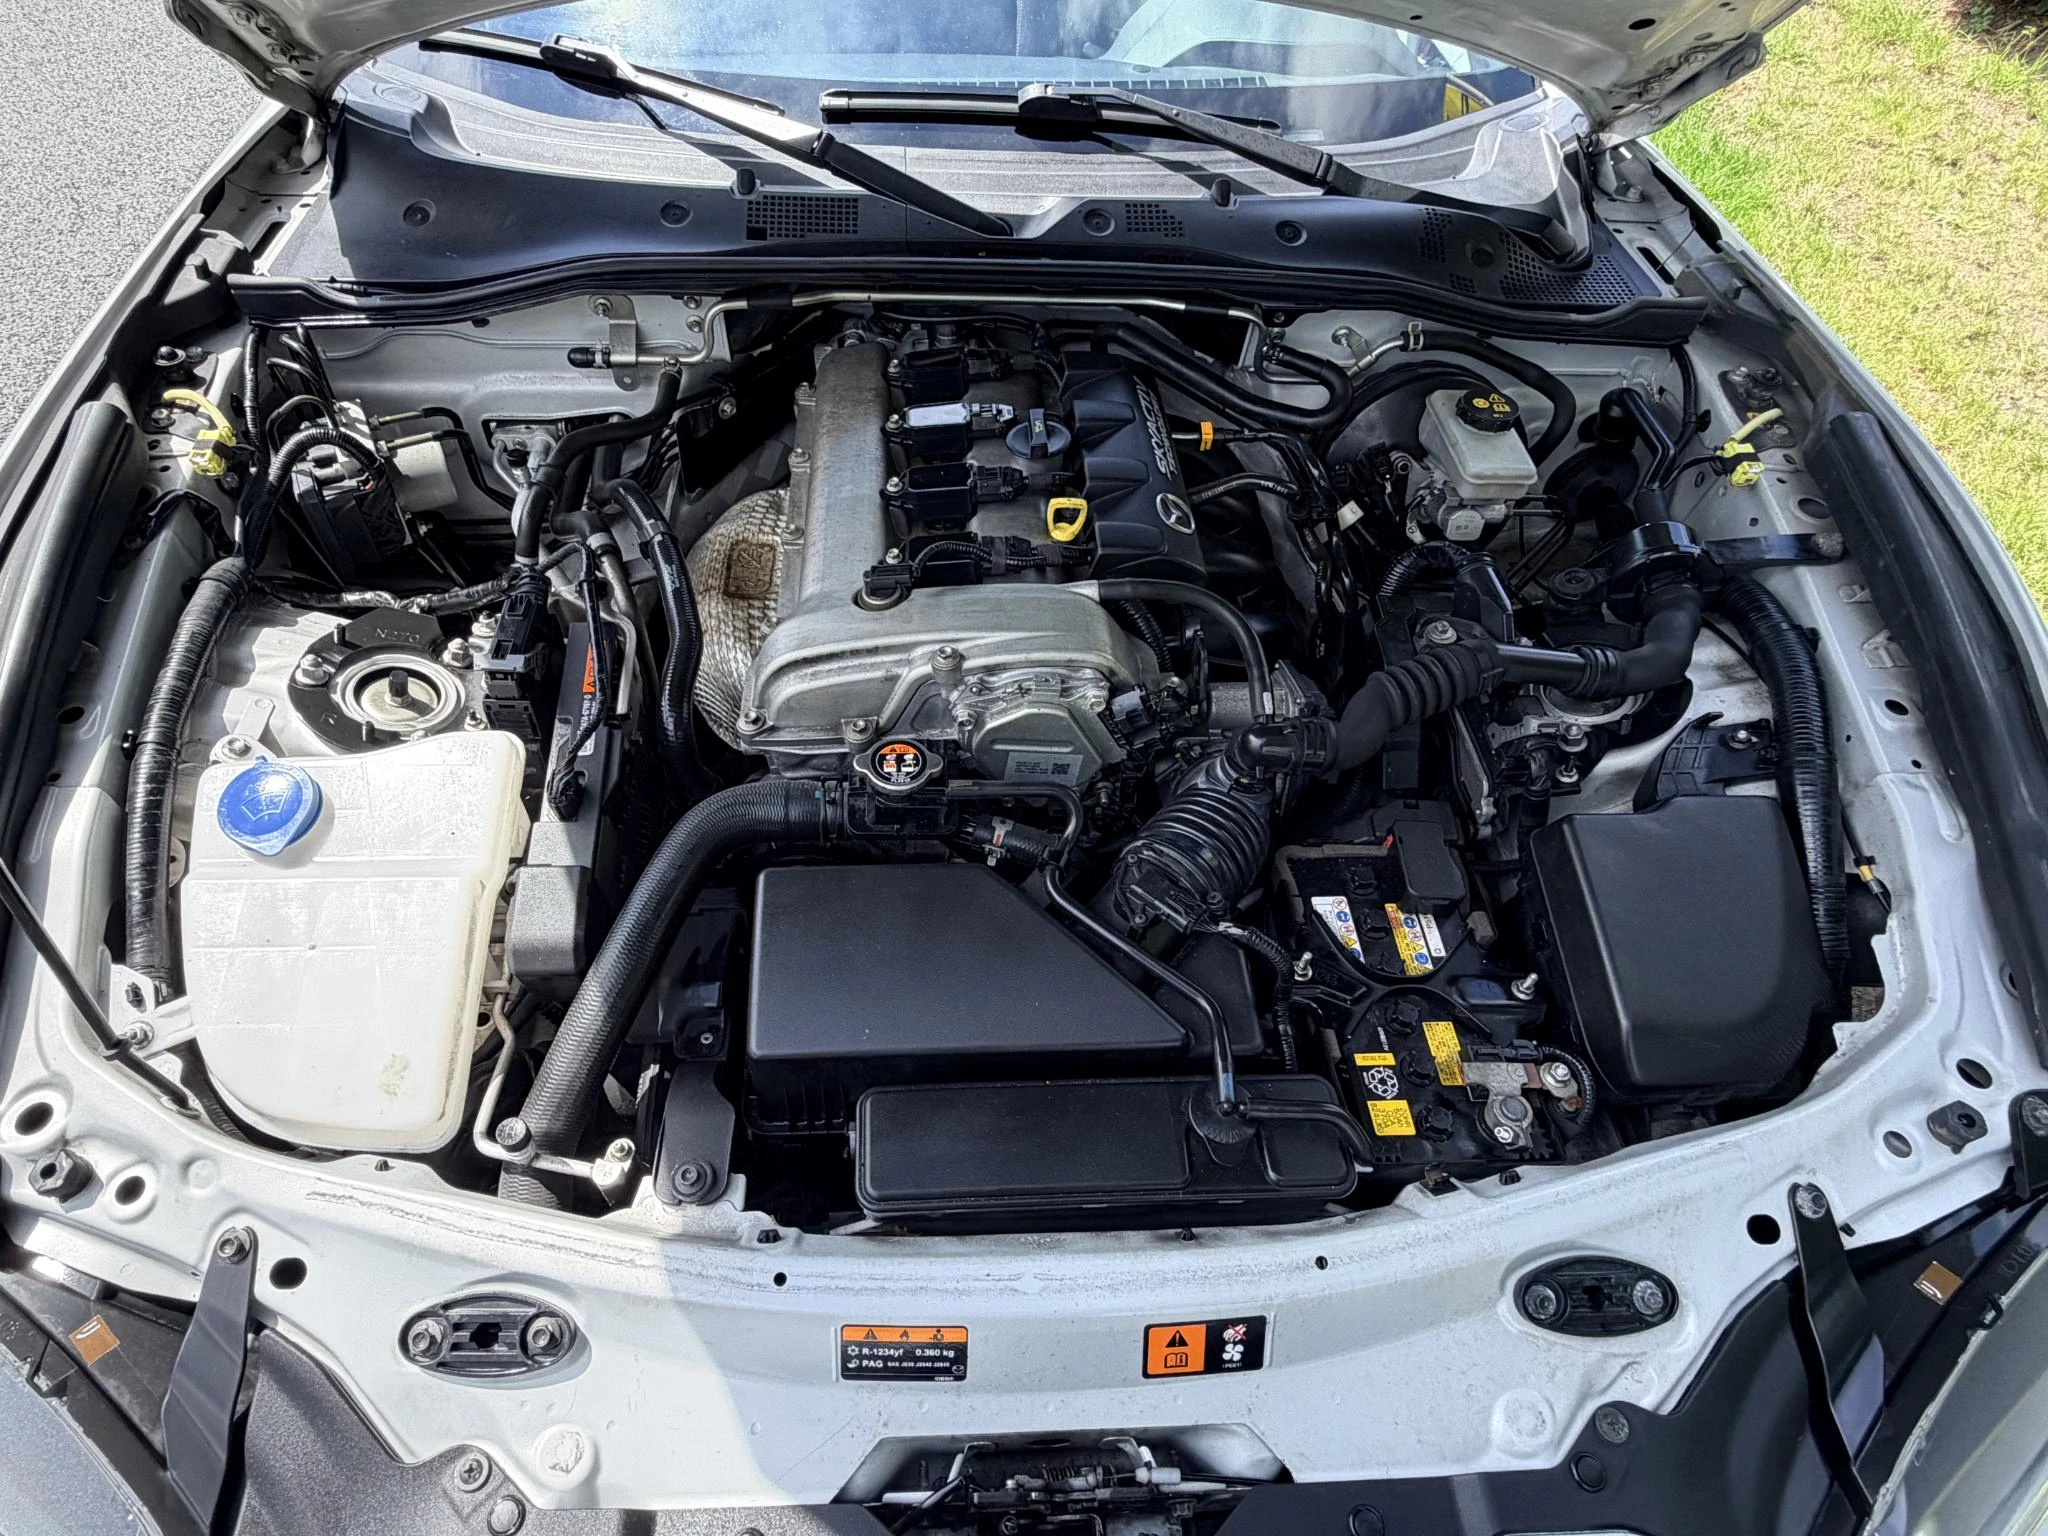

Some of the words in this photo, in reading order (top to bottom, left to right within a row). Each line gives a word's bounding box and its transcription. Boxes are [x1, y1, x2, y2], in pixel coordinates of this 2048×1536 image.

[1133, 375, 1172, 480] SKYACTIV
[862, 1348, 903, 1357] R-1234yf
[915, 1348, 940, 1357] 0.360
[943, 1349, 955, 1358] kg
[862, 1359, 884, 1368] PAG
